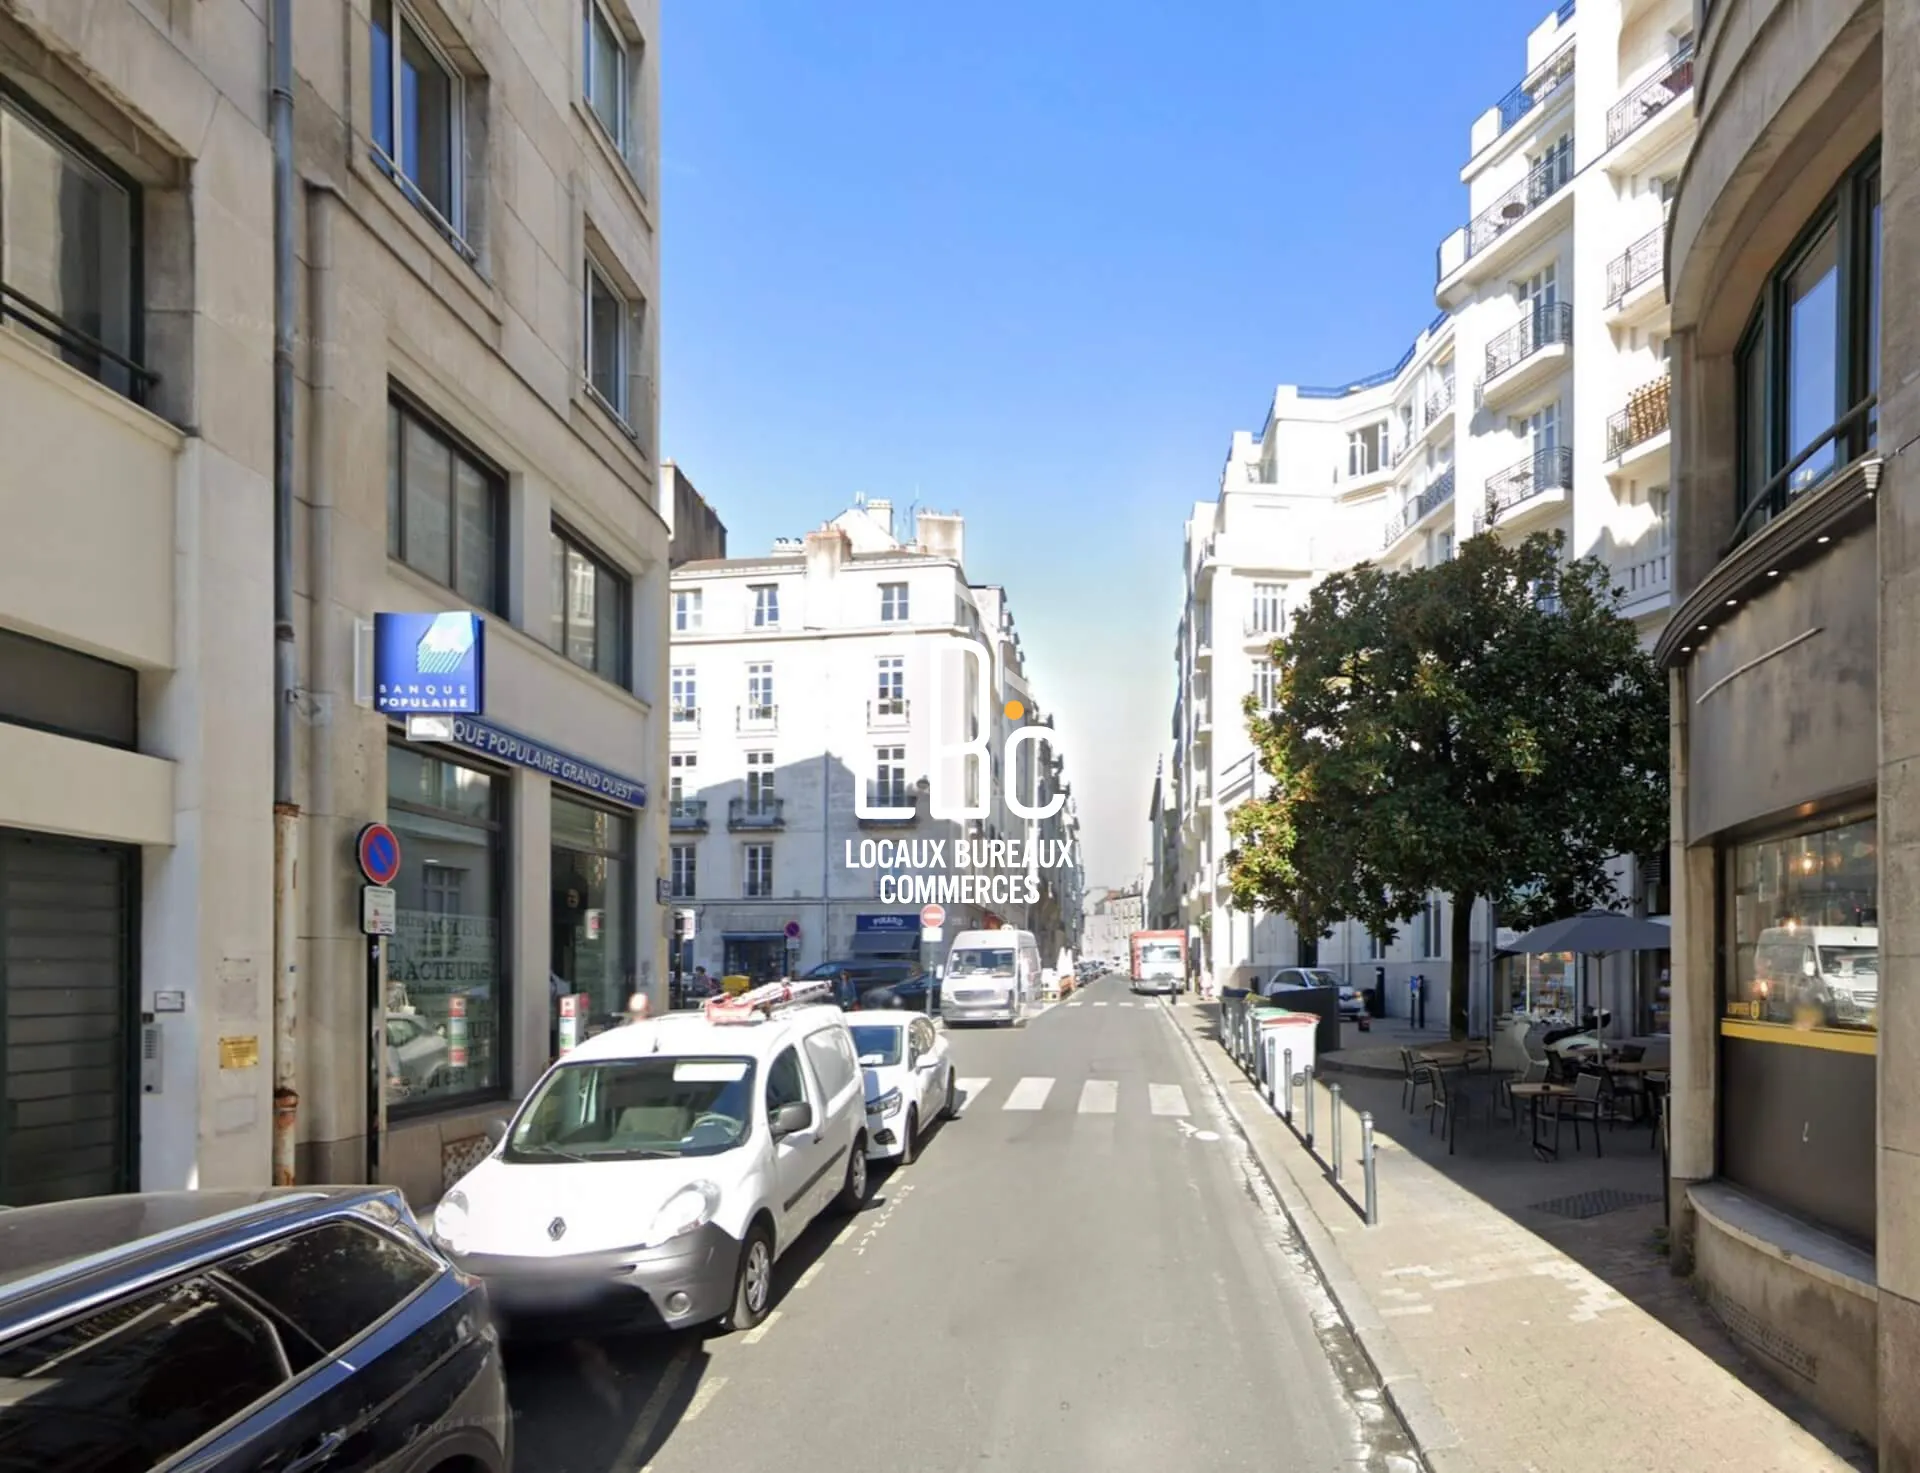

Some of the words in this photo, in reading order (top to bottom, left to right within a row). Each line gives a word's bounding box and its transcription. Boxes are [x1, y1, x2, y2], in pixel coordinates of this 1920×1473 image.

[379, 684, 467, 695] BANQUE
[380, 697, 467, 708] POPULAIRE
[453, 720, 486, 747] QUE
[488, 732, 560, 773] POPULAIRE
[561, 762, 600, 787] GRAND
[602, 778, 633, 800] OUEST
